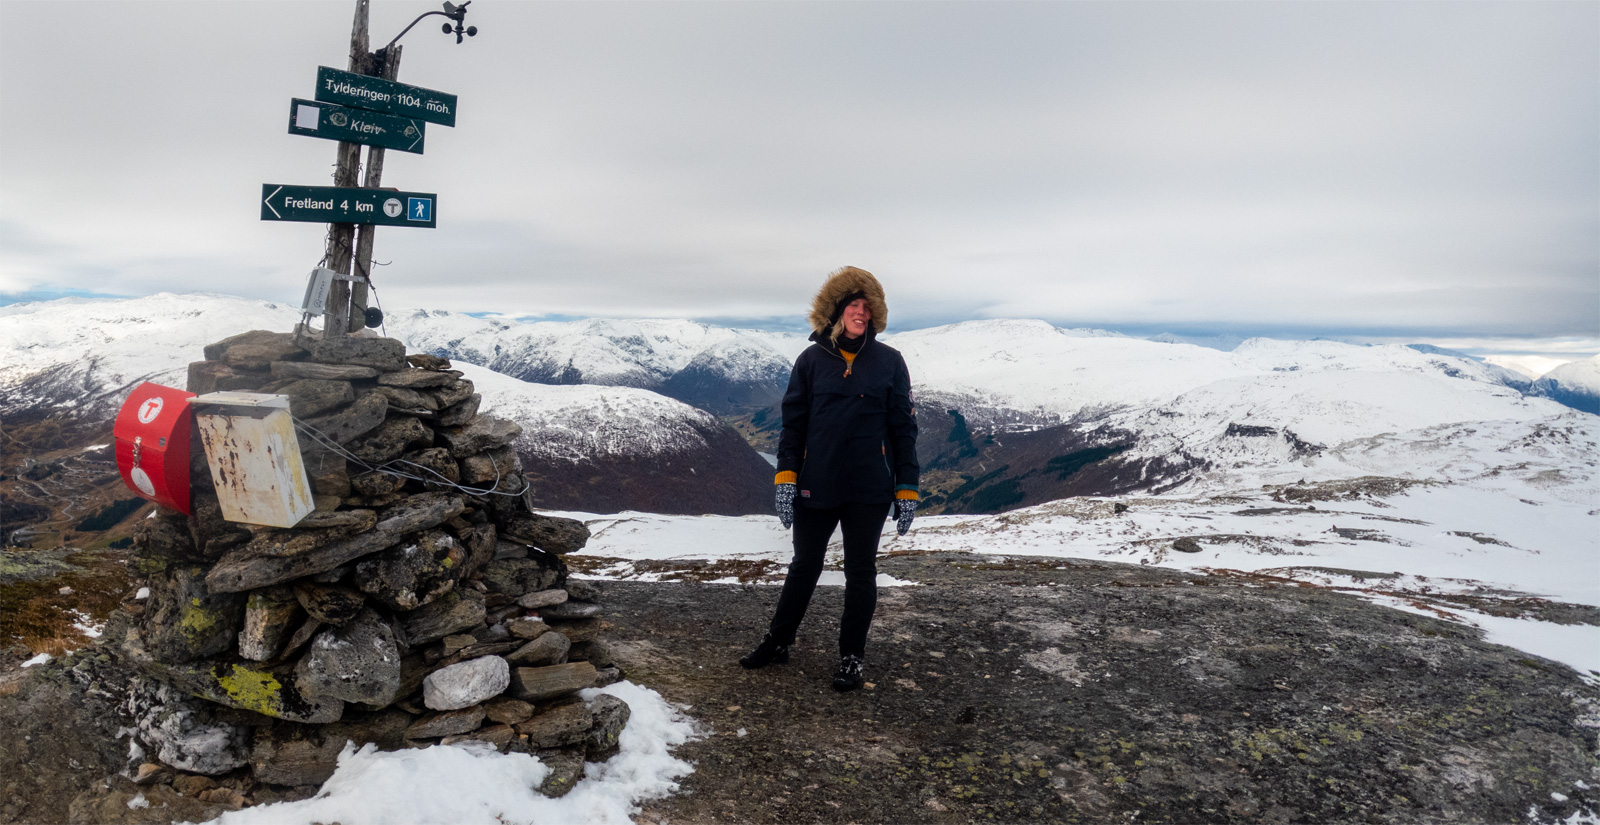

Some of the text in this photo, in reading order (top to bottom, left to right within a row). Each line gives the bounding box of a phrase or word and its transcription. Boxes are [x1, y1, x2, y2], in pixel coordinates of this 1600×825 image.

[326, 79, 451, 115] Tylderingen 1104 moh.
[350, 120, 382, 135] Kleiv
[285, 197, 334, 210] Fretland
[340, 200, 349, 210] 4
[356, 200, 374, 212] km
